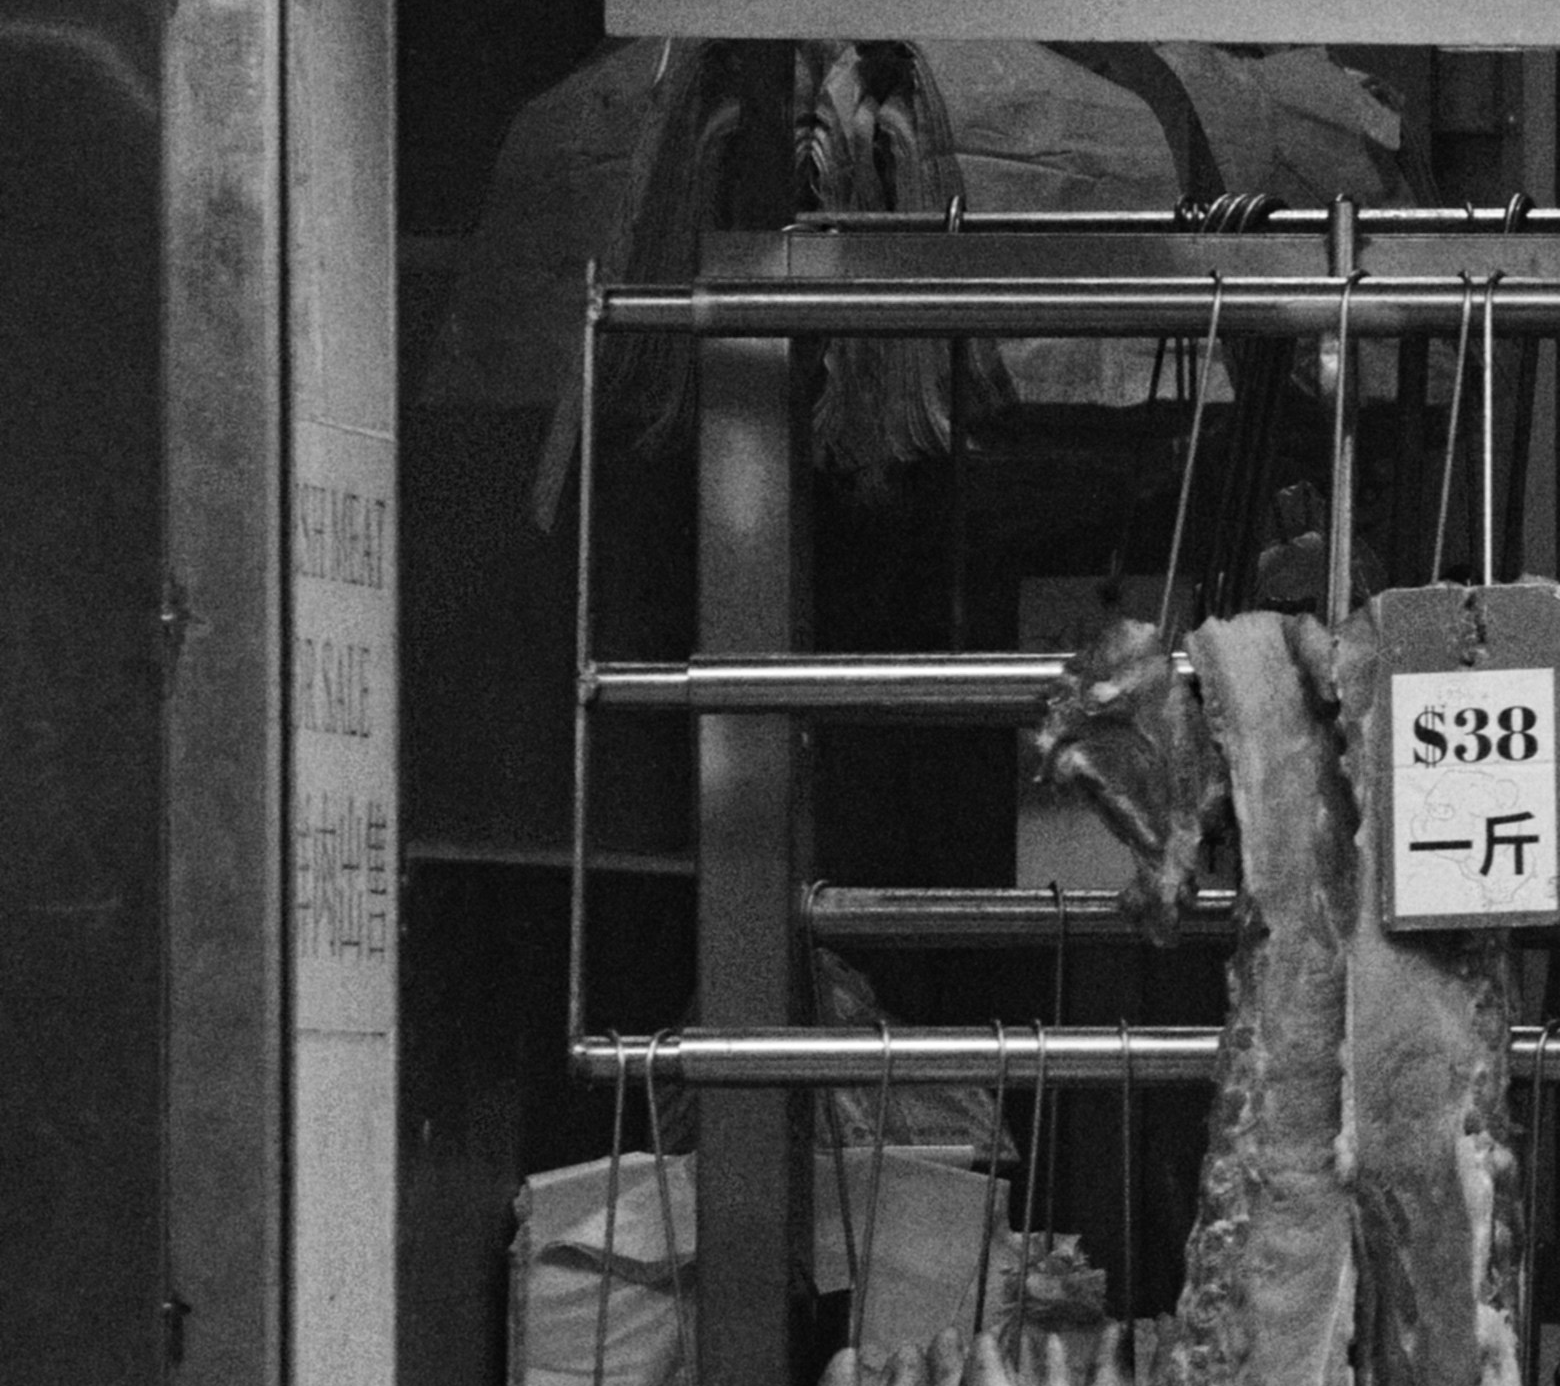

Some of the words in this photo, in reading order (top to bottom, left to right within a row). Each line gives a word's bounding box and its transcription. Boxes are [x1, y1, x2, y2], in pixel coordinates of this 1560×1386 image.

[331, 488, 387, 590] MEAT
[322, 637, 373, 740] SALE
[1413, 704, 1539, 768] $38
[1409, 811, 1540, 877] 一斤
